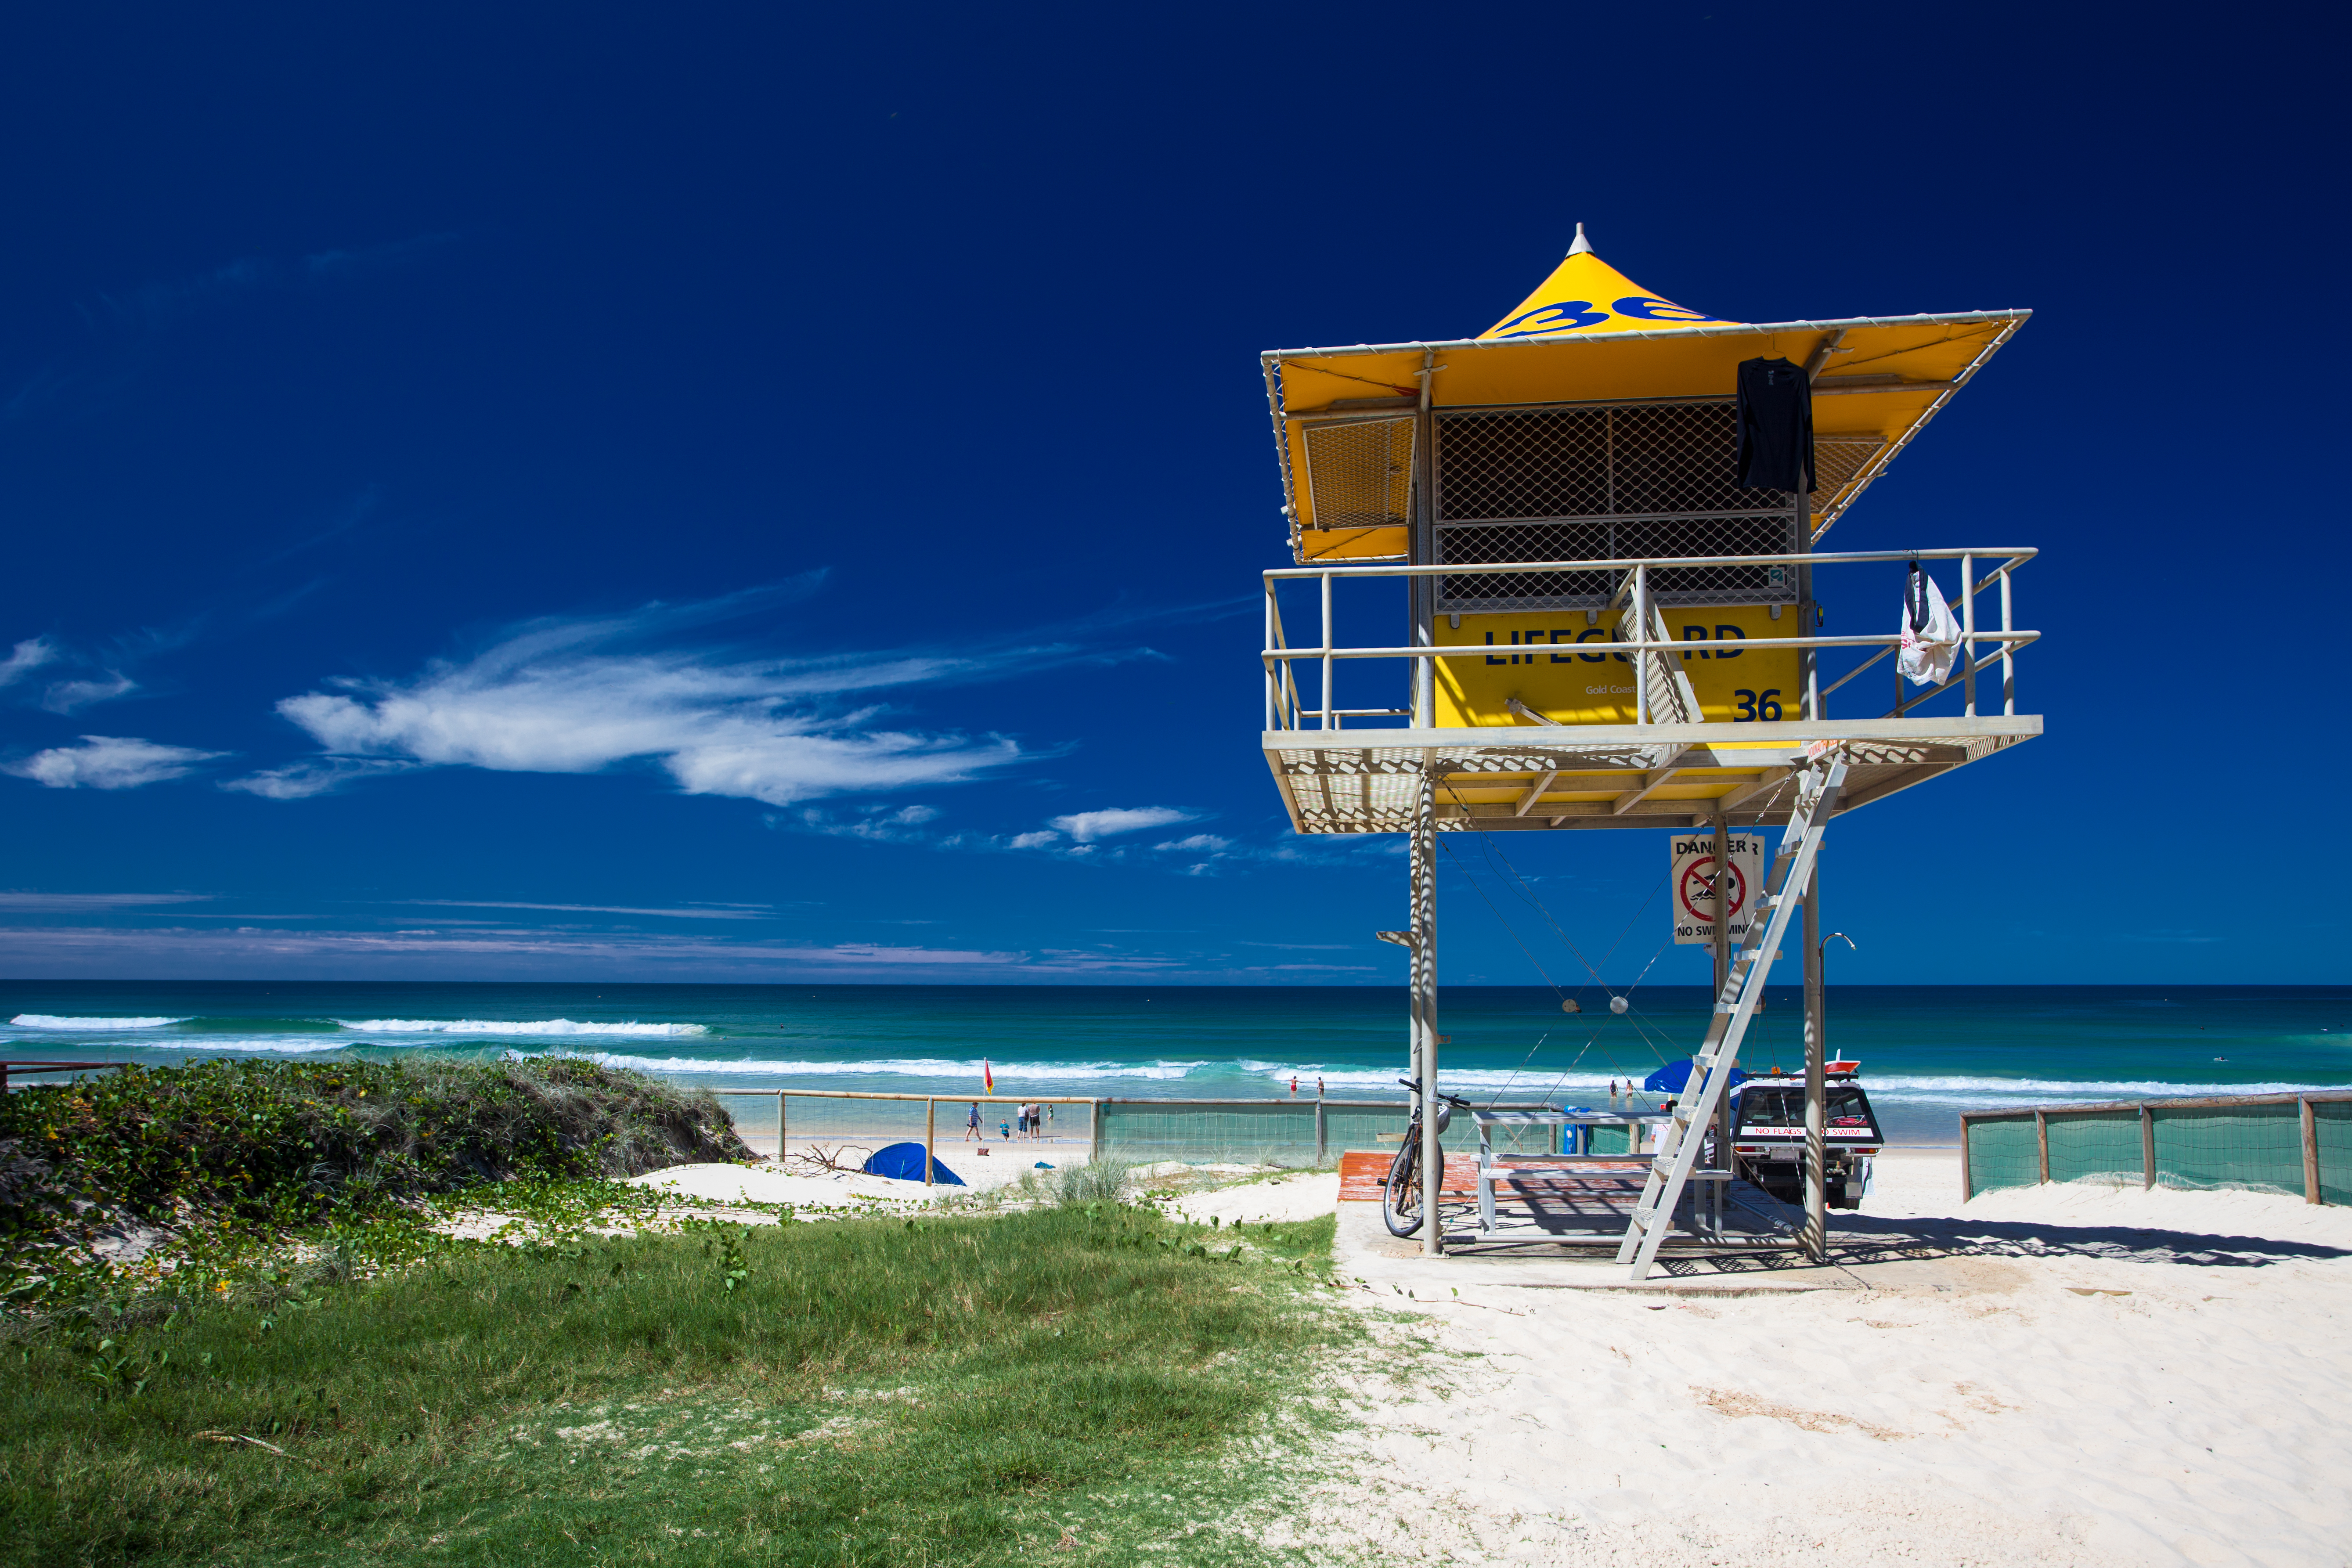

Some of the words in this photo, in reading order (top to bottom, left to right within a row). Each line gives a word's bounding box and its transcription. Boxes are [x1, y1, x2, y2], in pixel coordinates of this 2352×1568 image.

[1486, 624, 1746, 665] LIFEGRD
[1586, 685, 1607, 694] Gold
[1610, 685, 1636, 694] Coast
[1733, 688, 1783, 723] 36
[1676, 840, 1746, 854] DANER
[1677, 926, 1692, 936] NO
